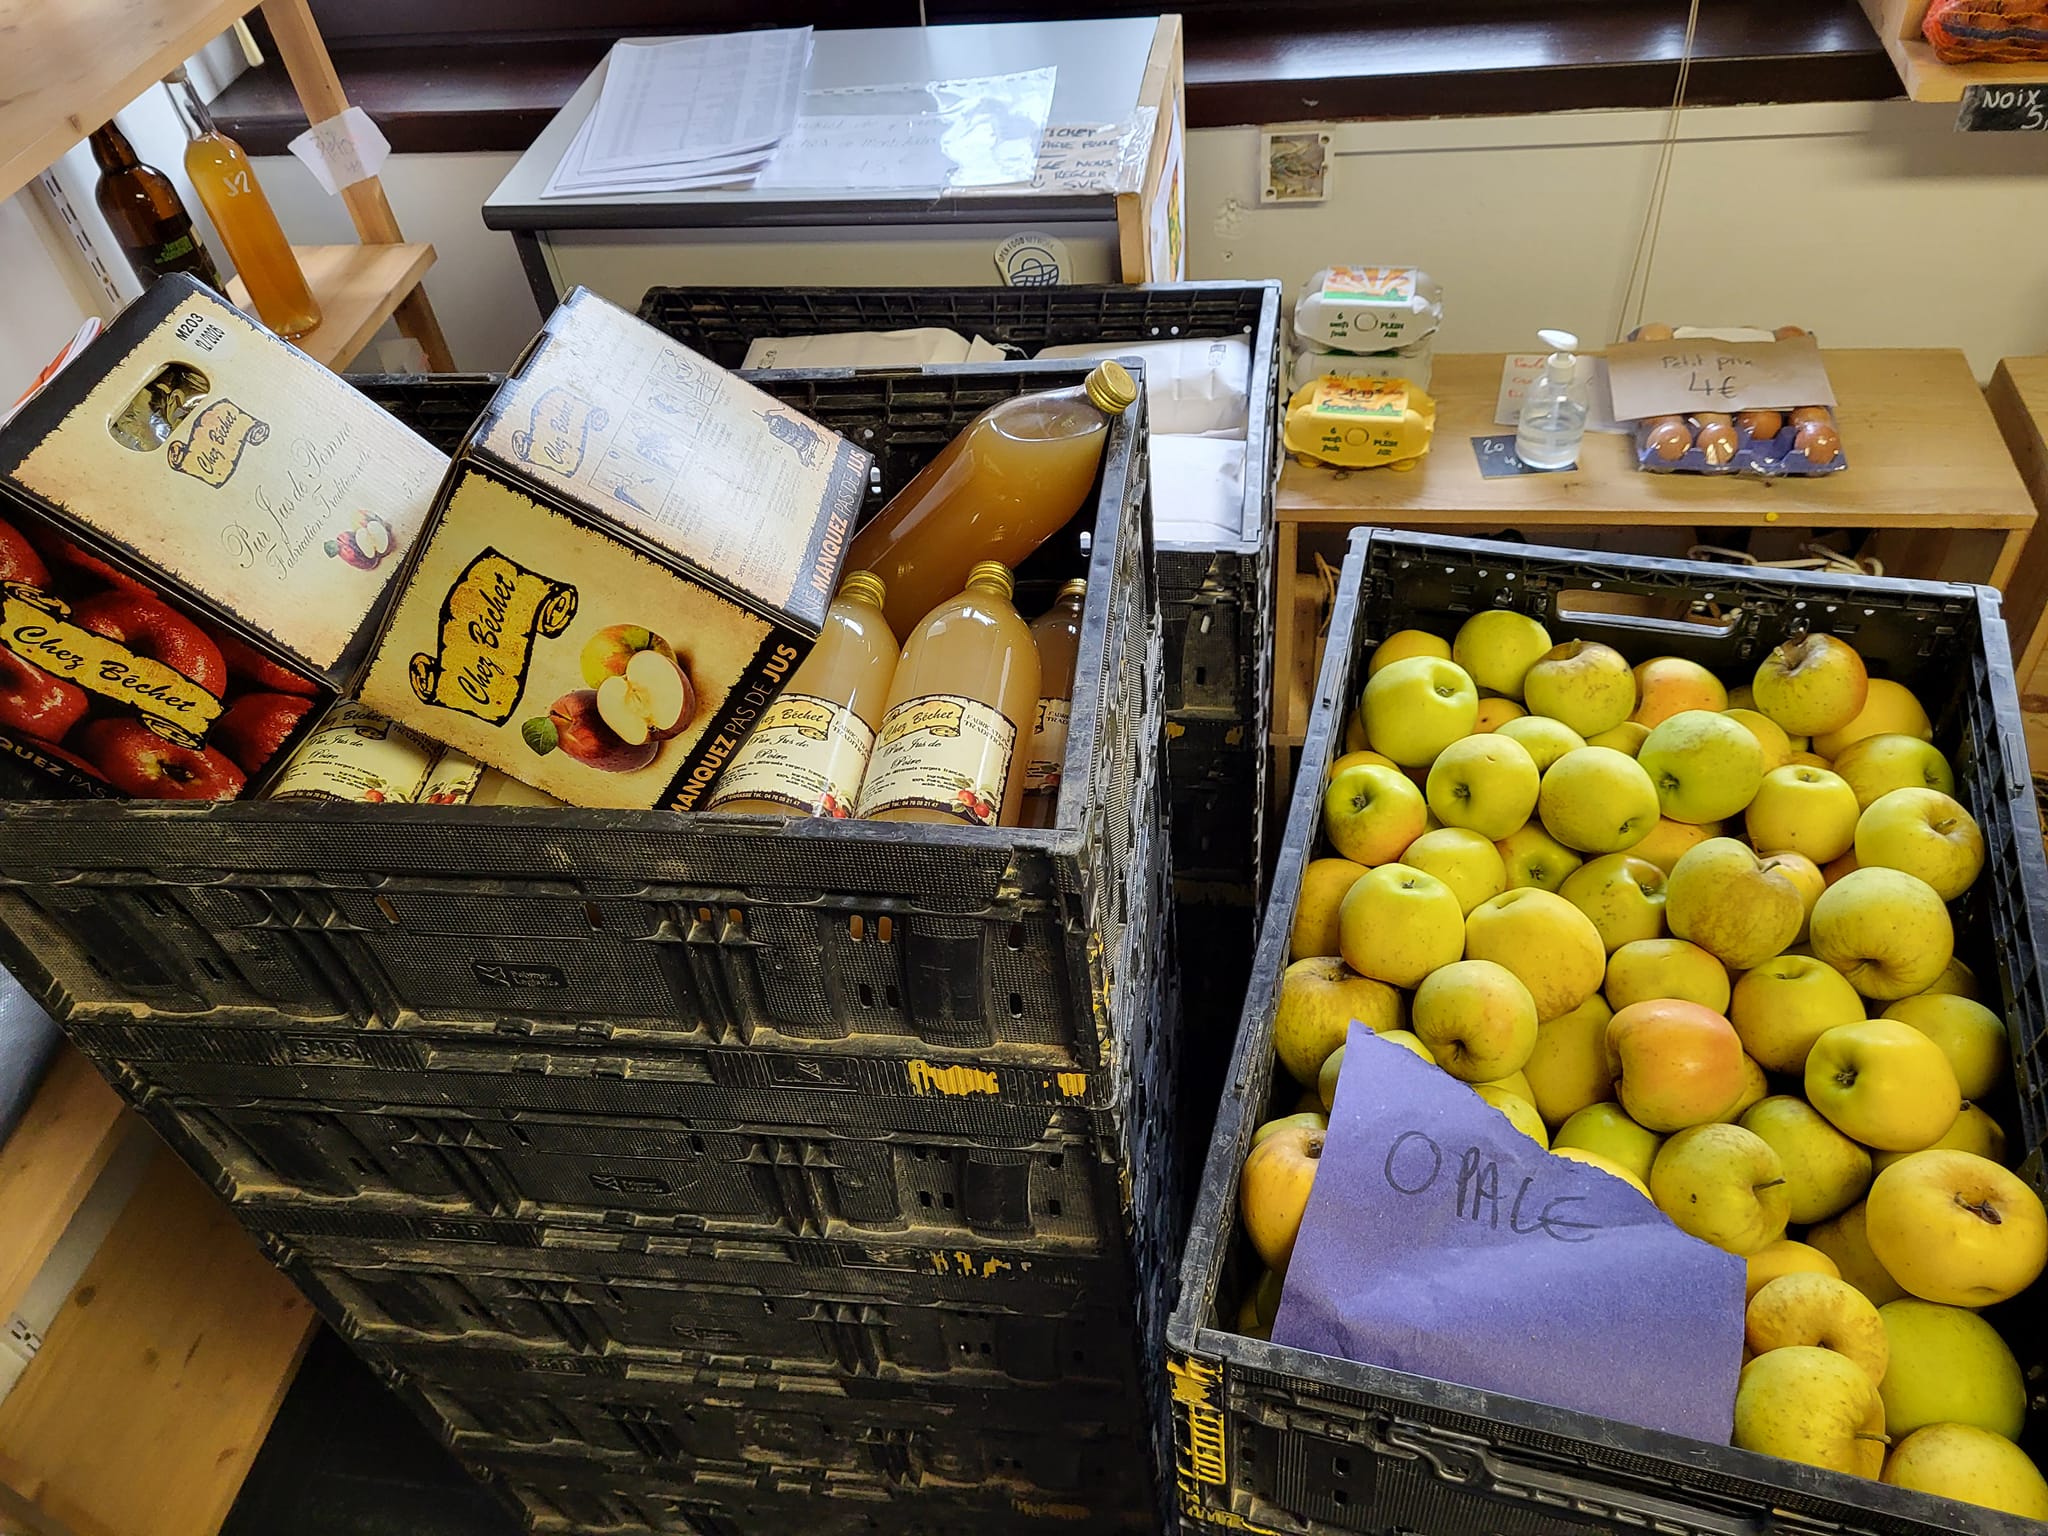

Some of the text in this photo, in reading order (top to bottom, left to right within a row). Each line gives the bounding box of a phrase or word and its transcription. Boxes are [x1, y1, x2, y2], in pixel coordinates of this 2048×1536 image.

[175, 312, 205, 342] M203
[1336, 312, 1344, 320] 6
[1379, 321, 1404, 330] PLEIN
[1384, 331, 1398, 339] AIR
[1661, 355, 1753, 372] Petit prix
[1688, 371, 1738, 399] 4€
[197, 410, 238, 475] Chez Béchet
[846, 449, 868, 479] JUS
[221, 421, 354, 570] Pur Jus de Pomme
[841, 472, 860, 495] DE
[834, 489, 856, 518] PAS
[265, 515, 325, 581] Fabrication
[810, 511, 849, 595] MANQUEZ
[457, 571, 517, 705] Chez Béchet
[13, 625, 197, 712] Chez Béchet
[724, 706, 757, 736] PAS
[743, 681, 774, 707] DE
[762, 643, 798, 684] JUS
[781, 708, 825, 723] Béchet
[883, 708, 955, 742] Chez Béchet
[324, 734, 349, 749] Jus
[349, 738, 364, 748] de
[747, 733, 809, 748] Pur Jus de
[883, 736, 943, 758] Pur Jus de
[308, 748, 339, 761] Poire
[753, 748, 788, 761] Poire
[890, 755, 922, 769] Poire
[69, 775, 106, 799] PAS
